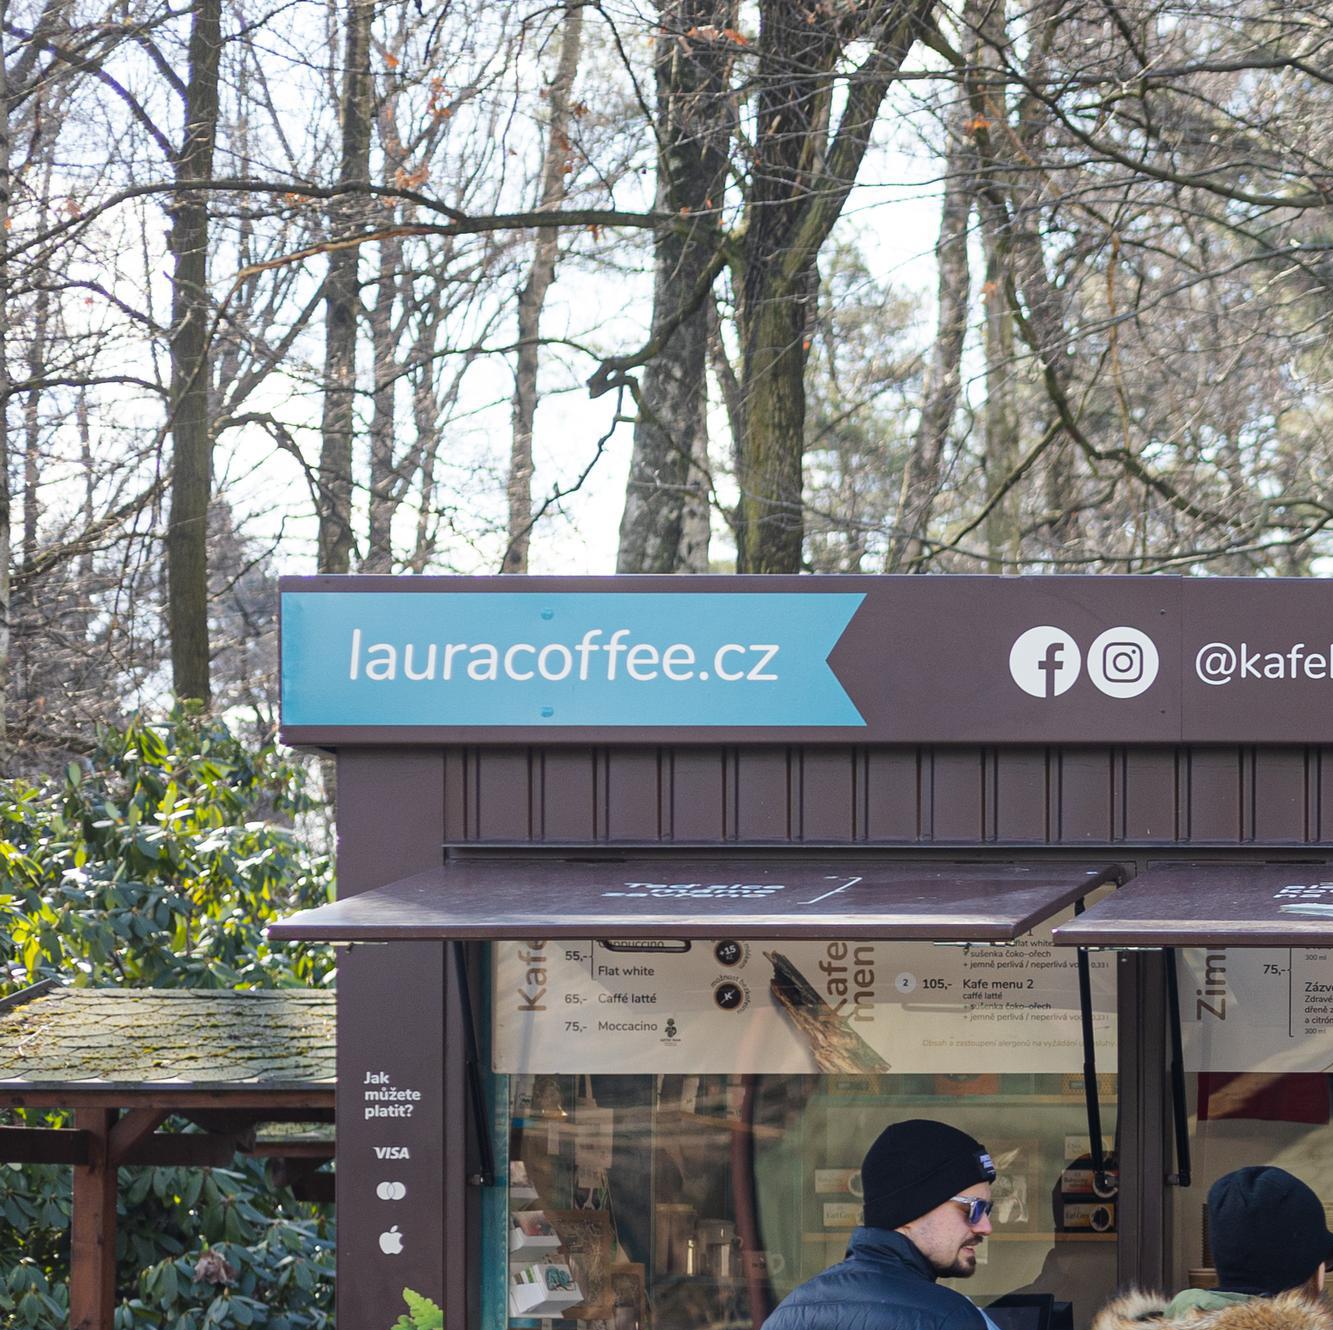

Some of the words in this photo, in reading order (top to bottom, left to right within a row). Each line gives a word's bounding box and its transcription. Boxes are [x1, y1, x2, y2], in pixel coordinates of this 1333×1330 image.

[348, 628, 780, 683] lauracoffee.cz
[970, 949, 1003, 958] sušenka
[970, 960, 995, 969] jemně
[997, 960, 1024, 969] perlivá
[1030, 960, 1068, 969] neperlivá
[1263, 964, 1286, 976] 75,-
[598, 966, 624, 976] Flat
[627, 966, 655, 976] white
[922, 979, 952, 991] 105,-
[963, 979, 988, 989] Kafe
[992, 981, 1023, 989] menu
[1027, 979, 1034, 989] 2
[564, 994, 588, 1005] 65,-
[598, 992, 628, 1004] Caffé
[631, 992, 657, 1004] latté
[962, 991, 980, 1000] caffé
[982, 991, 1003, 1000] latté
[1304, 995, 1333, 1004] Zdravé
[1304, 1005, 1328, 1014] dřeně
[970, 1013, 995, 1022] jemně
[997, 1013, 1024, 1022] perlivá
[1031, 1013, 1068, 1022] neperlivá
[564, 1022, 588, 1033] 75,-
[598, 1021, 658, 1031] Moccacino
[364, 1071, 390, 1085] Jak
[364, 1086, 422, 1101] můžete
[364, 1103, 414, 1119] platit?
[373, 1147, 411, 1160] VISA
